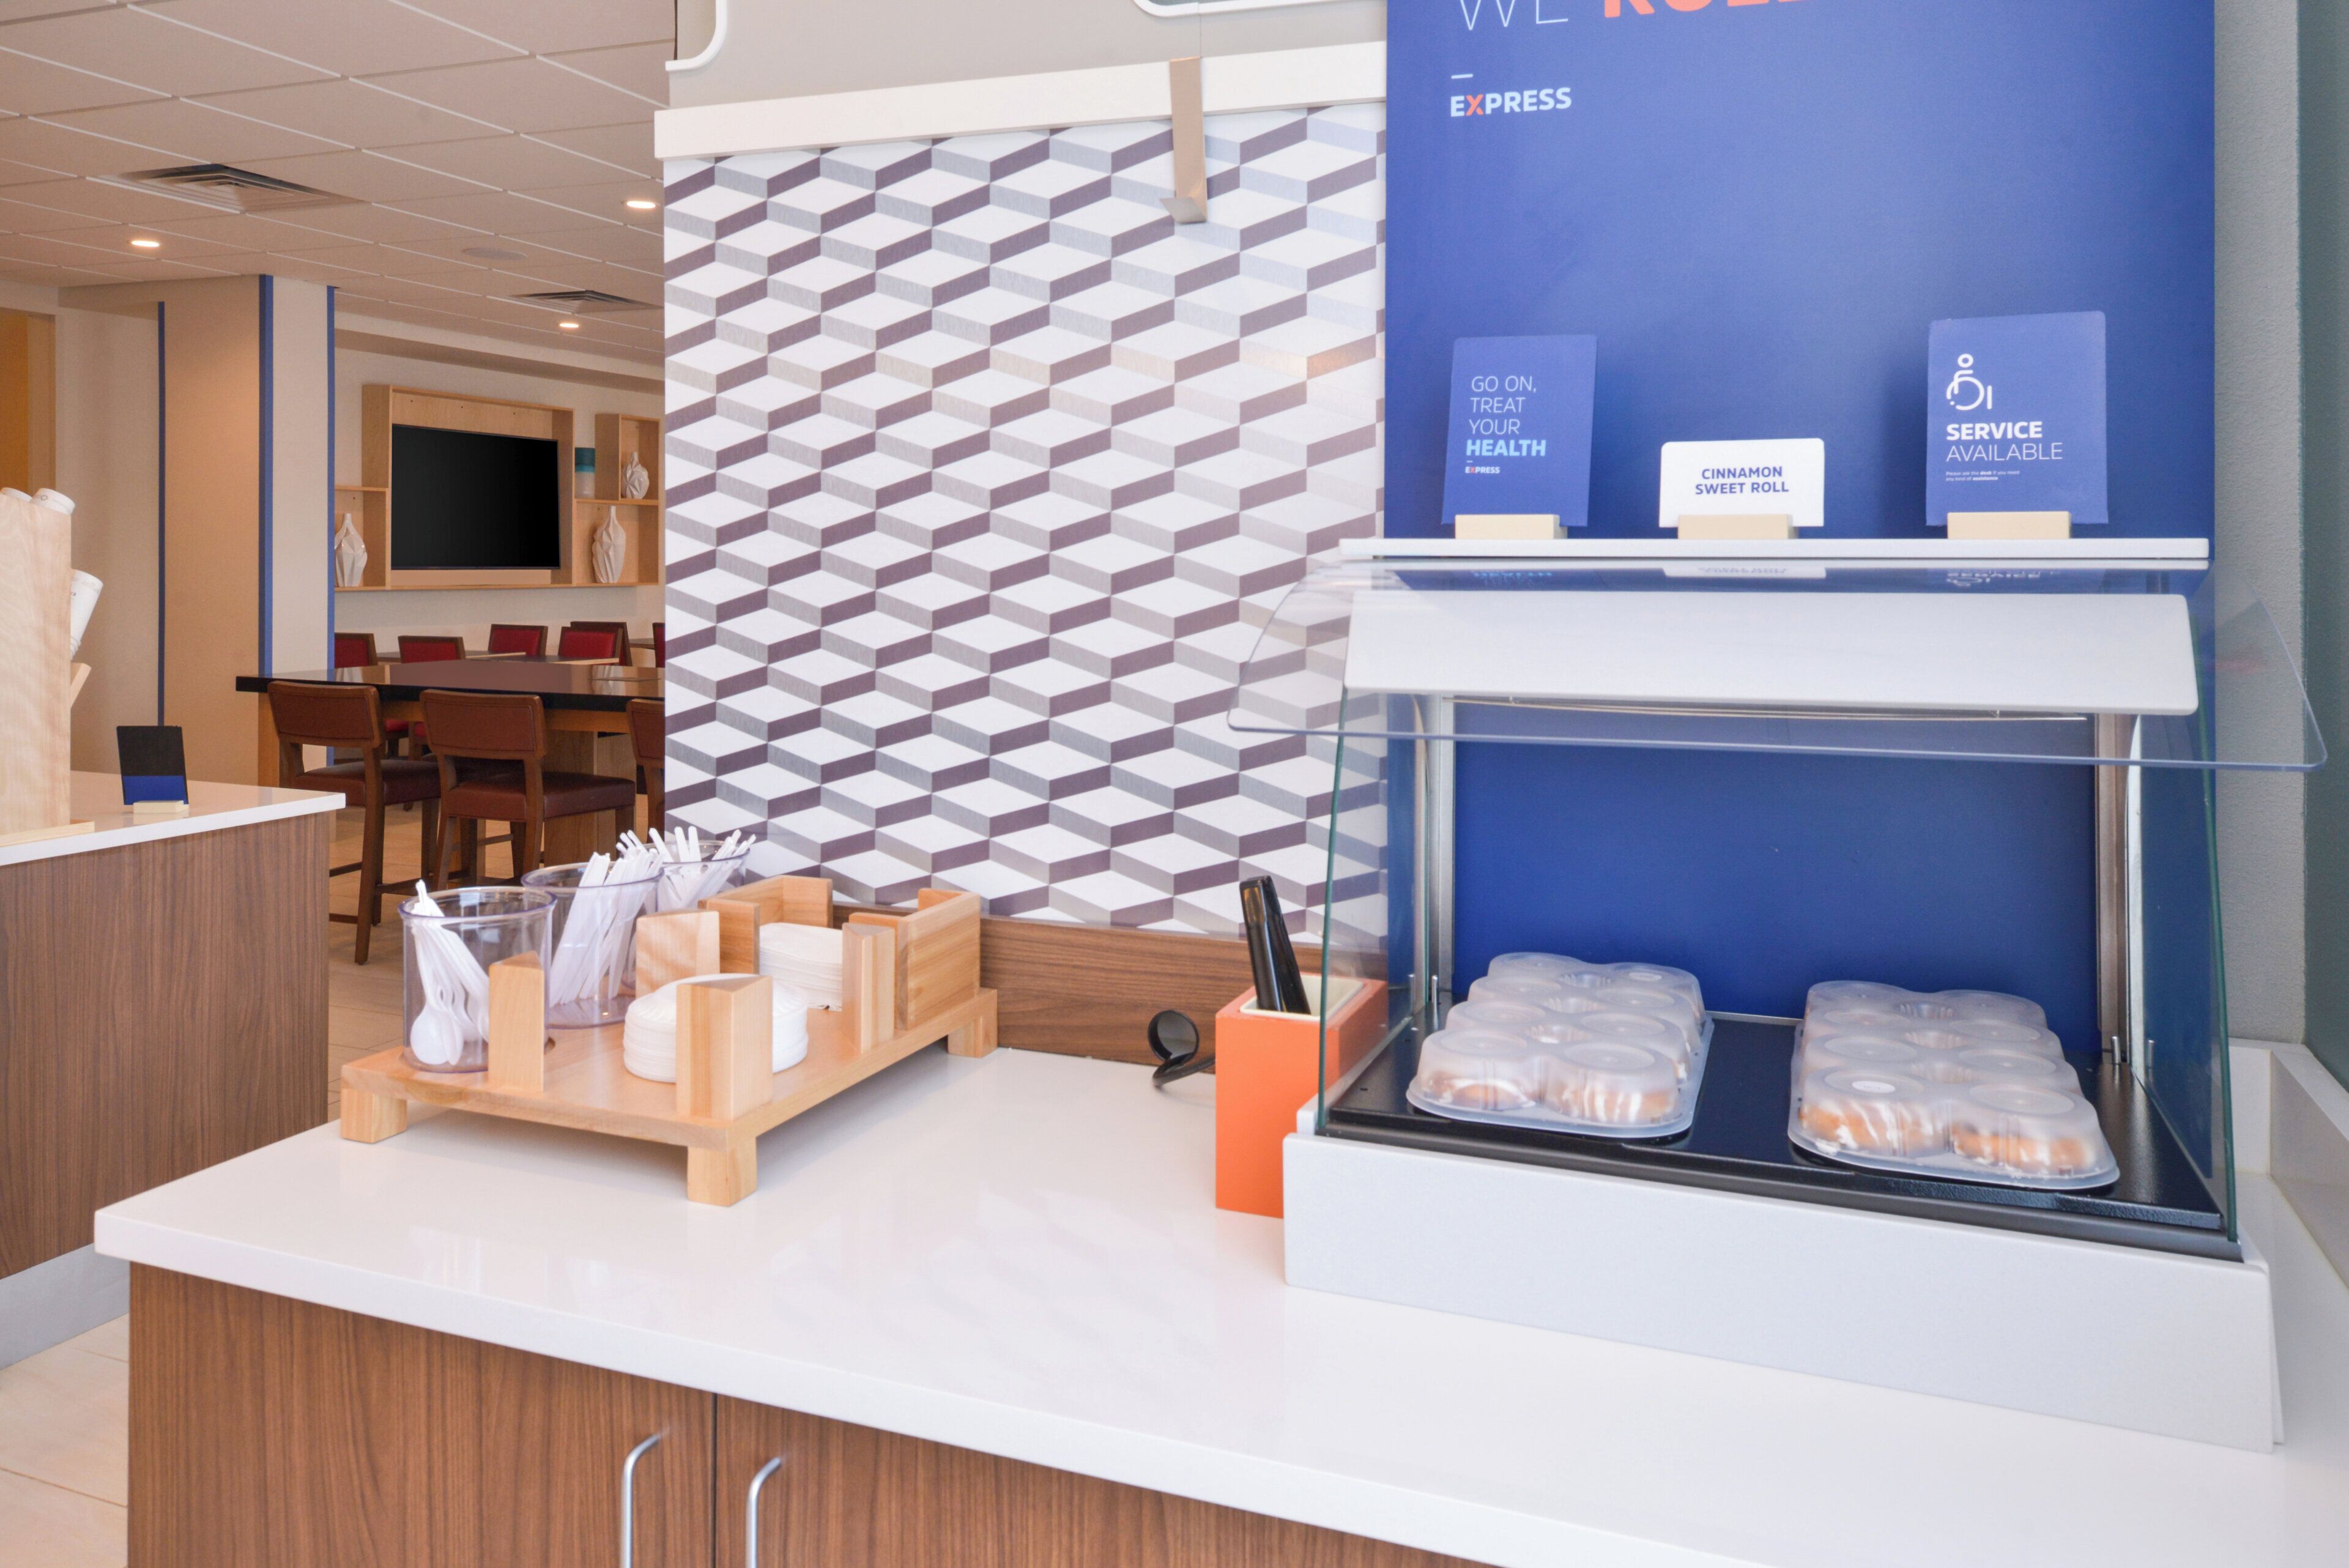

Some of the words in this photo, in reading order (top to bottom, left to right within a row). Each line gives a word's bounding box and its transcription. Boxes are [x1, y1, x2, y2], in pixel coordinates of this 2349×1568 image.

[1451, 87, 1571, 116] EXPRESS
[1472, 376, 1498, 392] GO
[1505, 376, 1536, 392] ON,
[1471, 398, 1525, 412] TREAT
[1469, 419, 1520, 434] YOUR
[1946, 422, 2043, 440] SERVICE
[1466, 439, 1546, 456] HEALTH
[1946, 443, 2062, 461] AVAILABLE
[1702, 467, 1781, 479] CINNAMON
[1696, 483, 1745, 494] SWEET
[1751, 481, 1789, 492] ROLL
